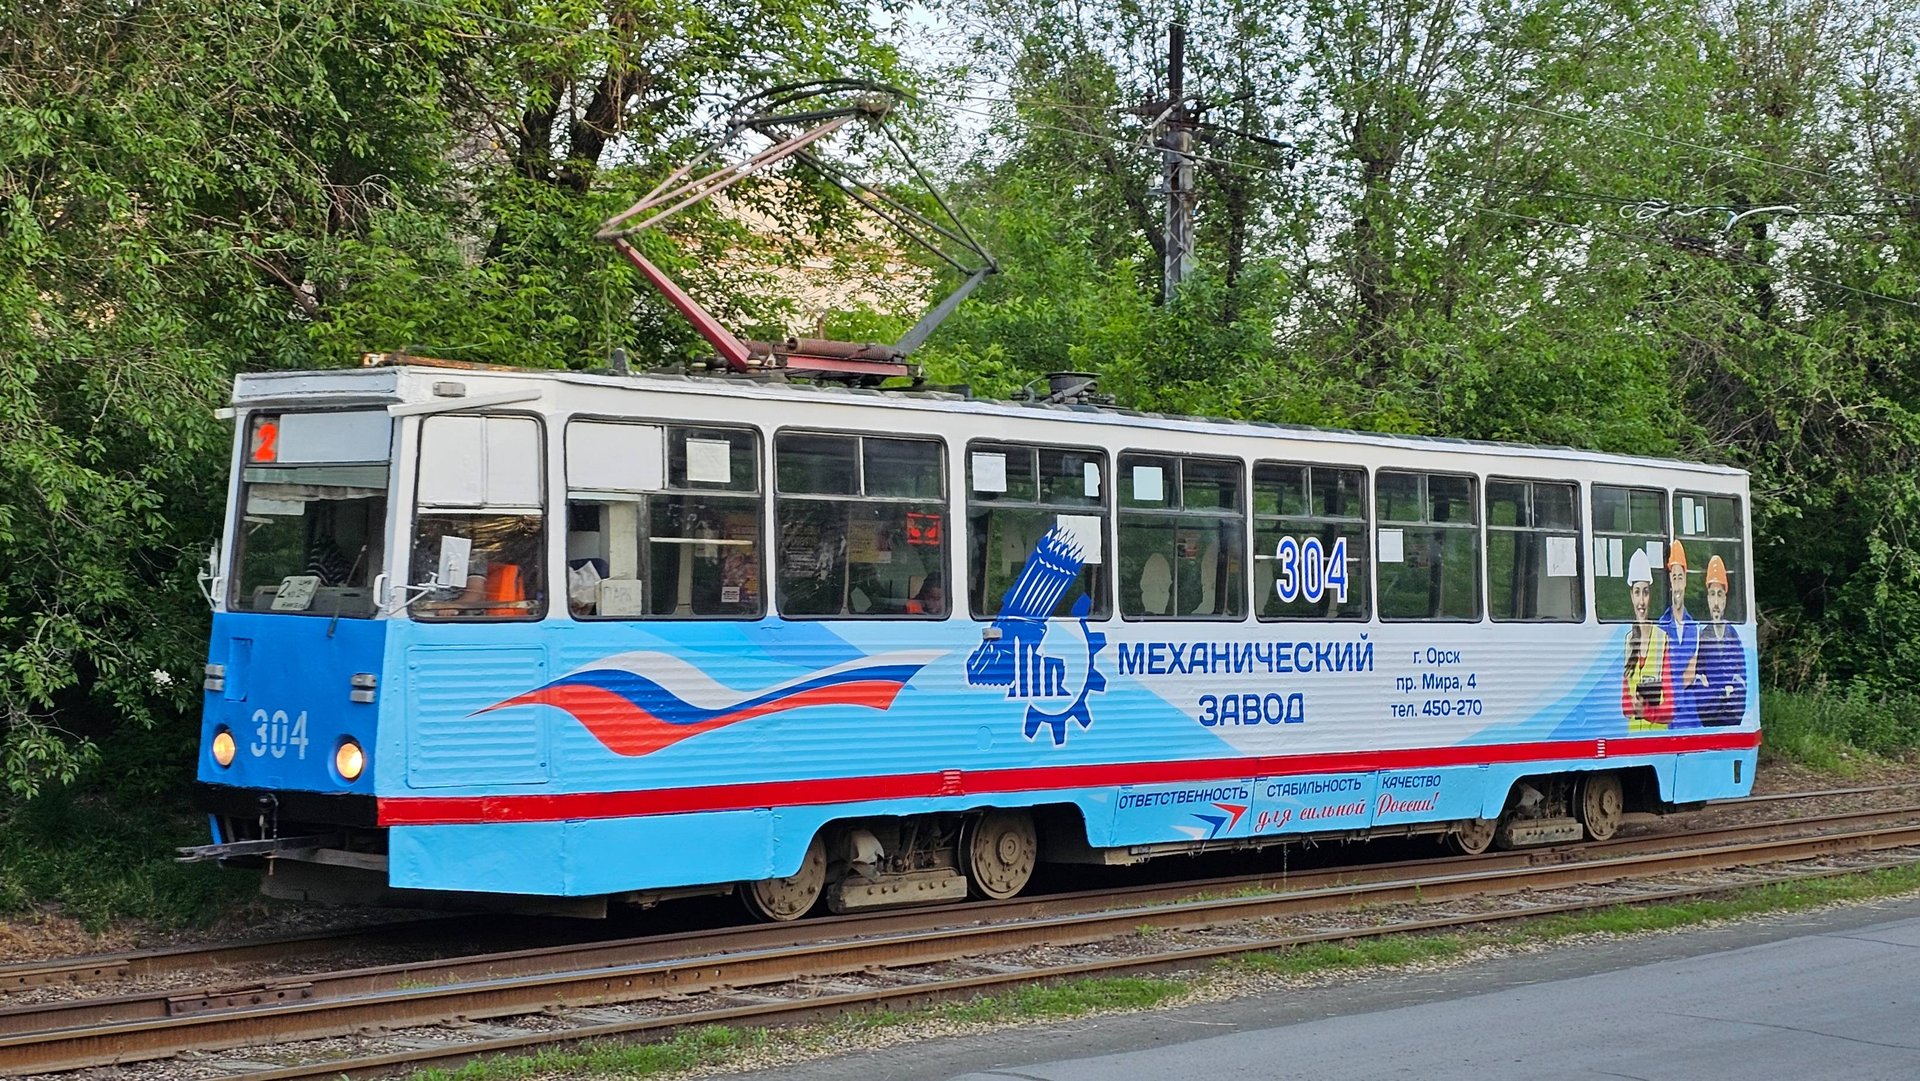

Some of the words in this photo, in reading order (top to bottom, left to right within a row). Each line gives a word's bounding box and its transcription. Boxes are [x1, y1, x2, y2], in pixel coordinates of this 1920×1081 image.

[253, 423, 277, 461] 2
[1277, 536, 1348, 603] 304
[277, 580, 291, 598] 2
[1118, 633, 1374, 675] МЕХАНИЧЕСКИЙ
[1413, 651, 1421, 664] г.
[1426, 647, 1461, 667] Орск
[1396, 677, 1417, 693] пр.
[1422, 673, 1463, 693] Мира,
[1467, 673, 1476, 689] 4
[1198, 692, 1304, 727] ЗАВОД
[1391, 703, 1418, 718] тел.
[1422, 699, 1483, 716] 450-270
[251, 708, 309, 760] 304
[1119, 786, 1248, 810] ОТВЕТСТВЕННОСТЬ
[1267, 777, 1362, 799] СТАБИЛЬНОСТЬ
[1382, 775, 1441, 789] КАЧЕСТВО
[1254, 808, 1292, 833] для
[1299, 798, 1366, 821] сильной
[1374, 792, 1438, 818] России!
